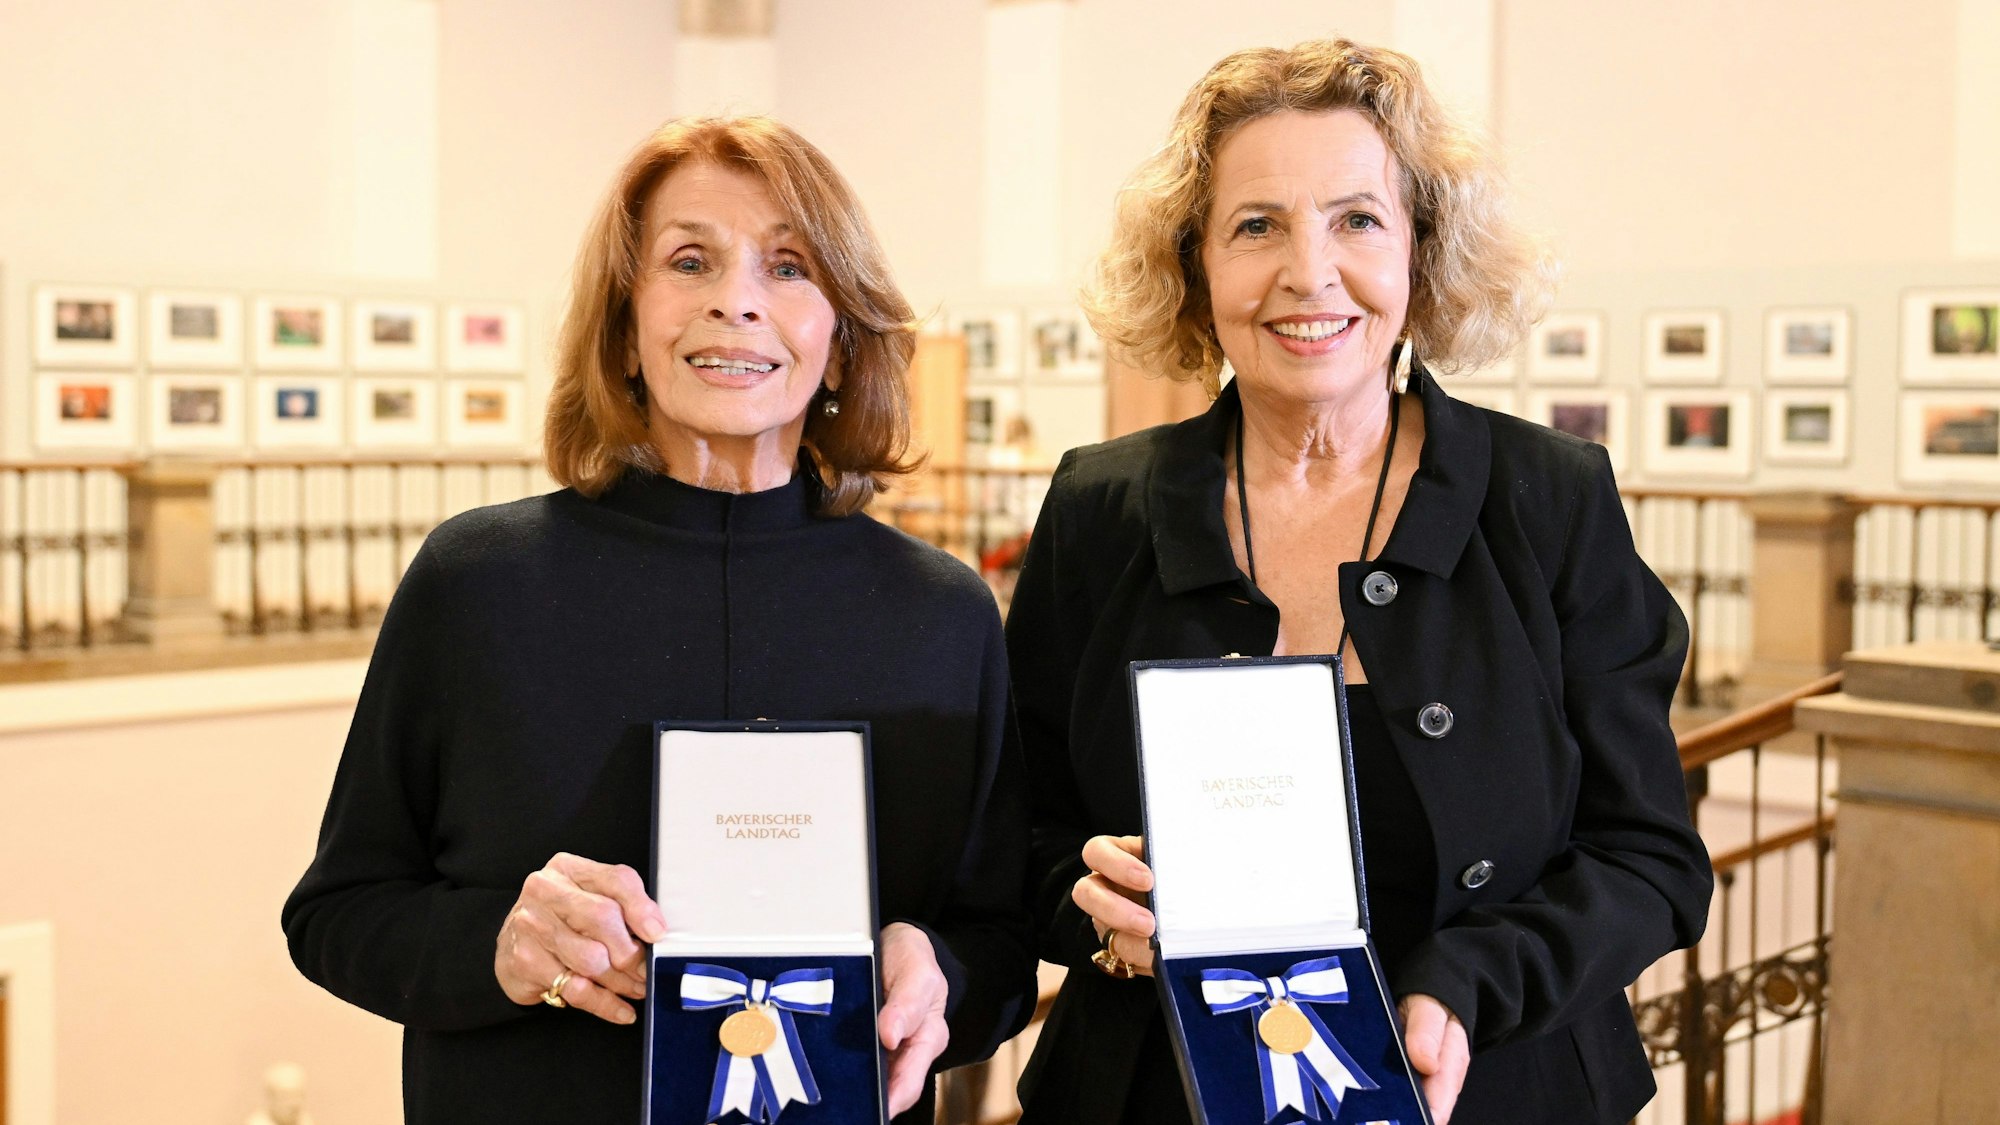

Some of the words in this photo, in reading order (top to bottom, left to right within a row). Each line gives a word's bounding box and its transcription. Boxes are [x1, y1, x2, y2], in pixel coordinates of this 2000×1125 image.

[1201, 775, 1295, 792] BAYERISCHER
[1213, 793, 1284, 809] LANDTAG
[716, 814, 813, 825] BAYERISCHER
[726, 828, 800, 839] LANDTAG
